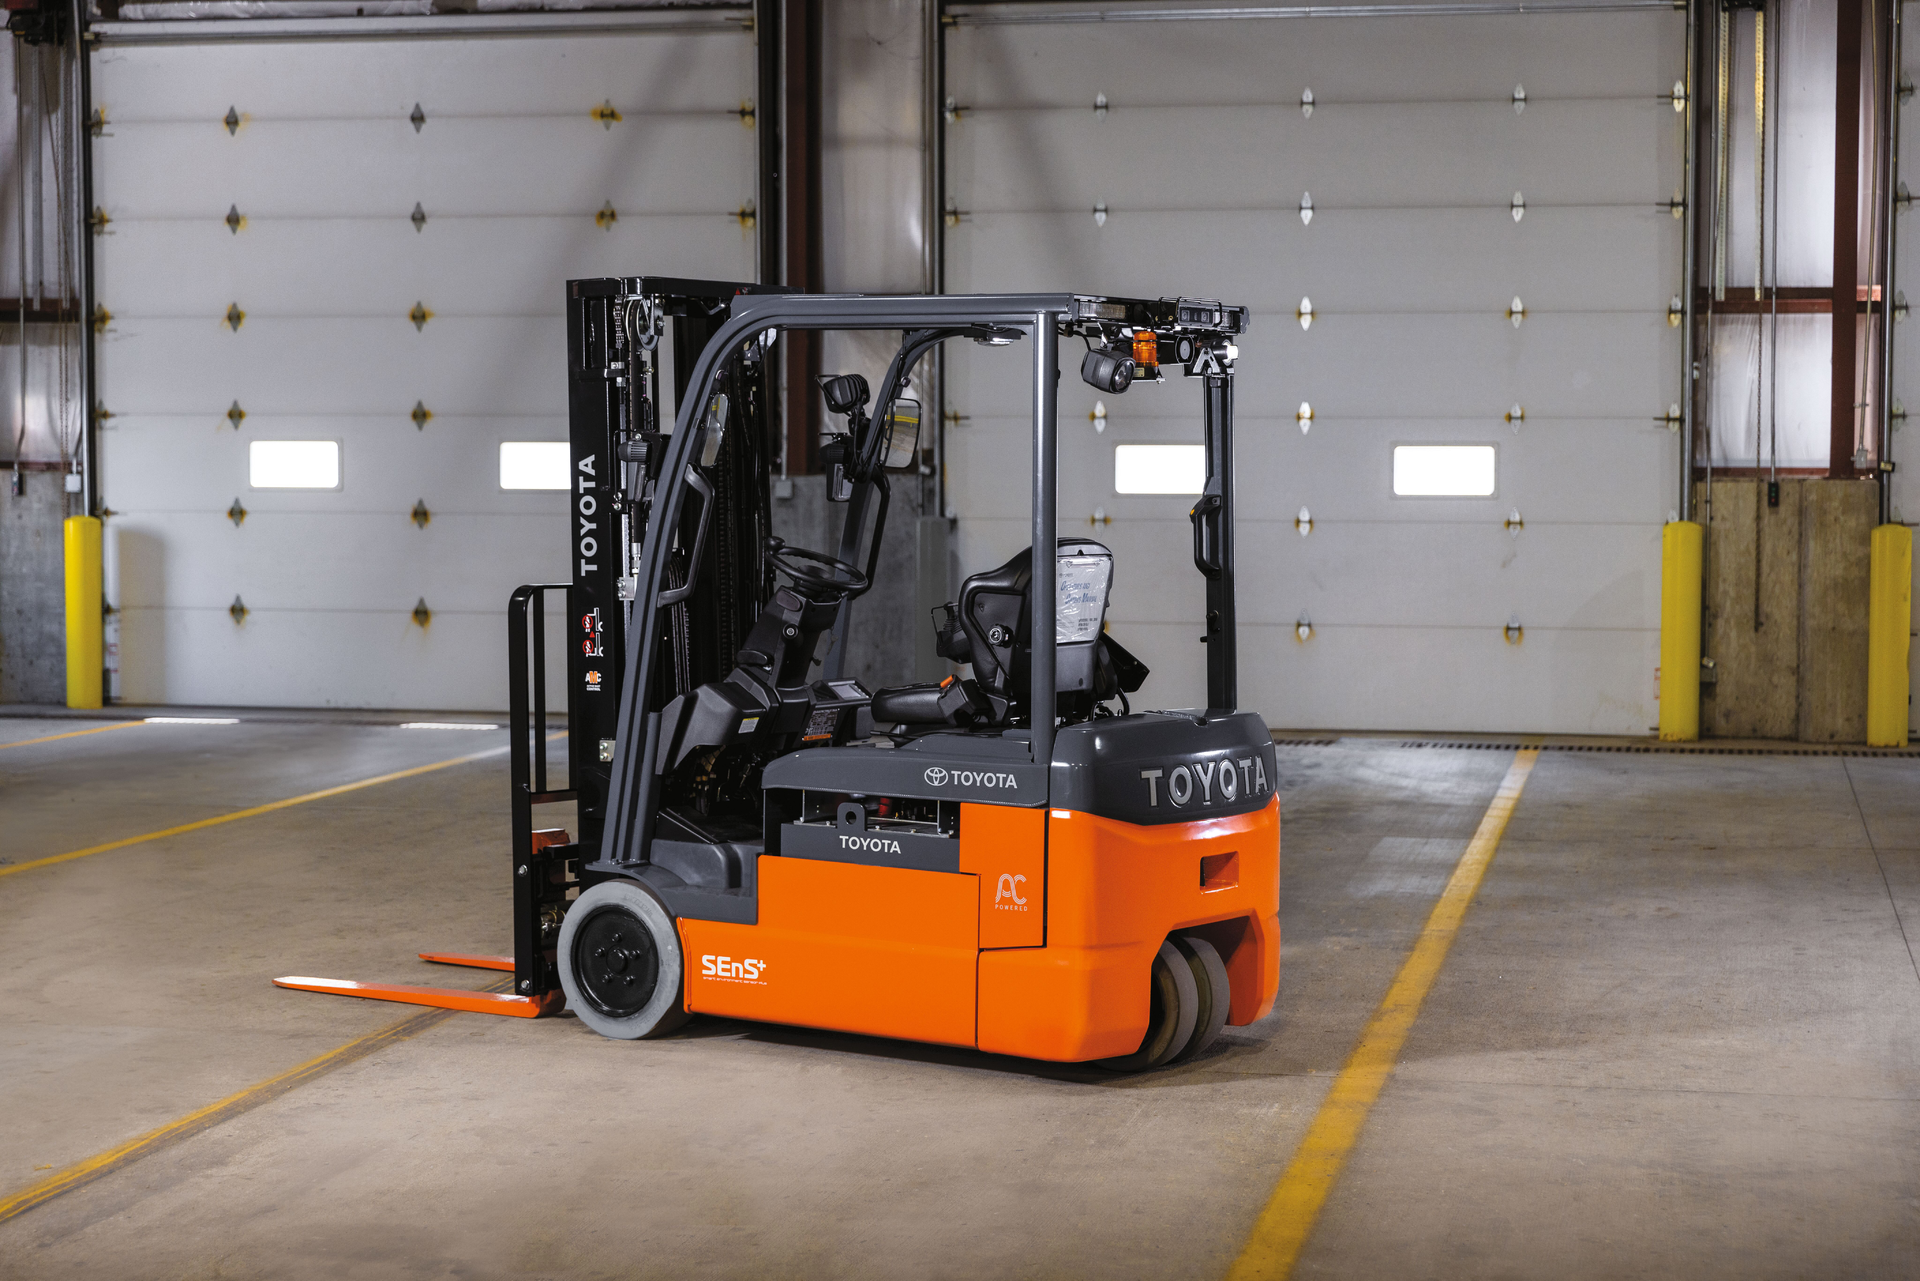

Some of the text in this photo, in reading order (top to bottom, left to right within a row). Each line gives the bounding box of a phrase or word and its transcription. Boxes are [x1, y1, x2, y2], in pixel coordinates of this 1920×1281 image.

[579, 454, 598, 576] TOYOTA
[951, 770, 1017, 789] TOYOTA
[1141, 756, 1268, 807] TOYOTA
[839, 835, 901, 854] TOYOTA
[995, 873, 1027, 905] AC
[995, 904, 1028, 912] POWERED
